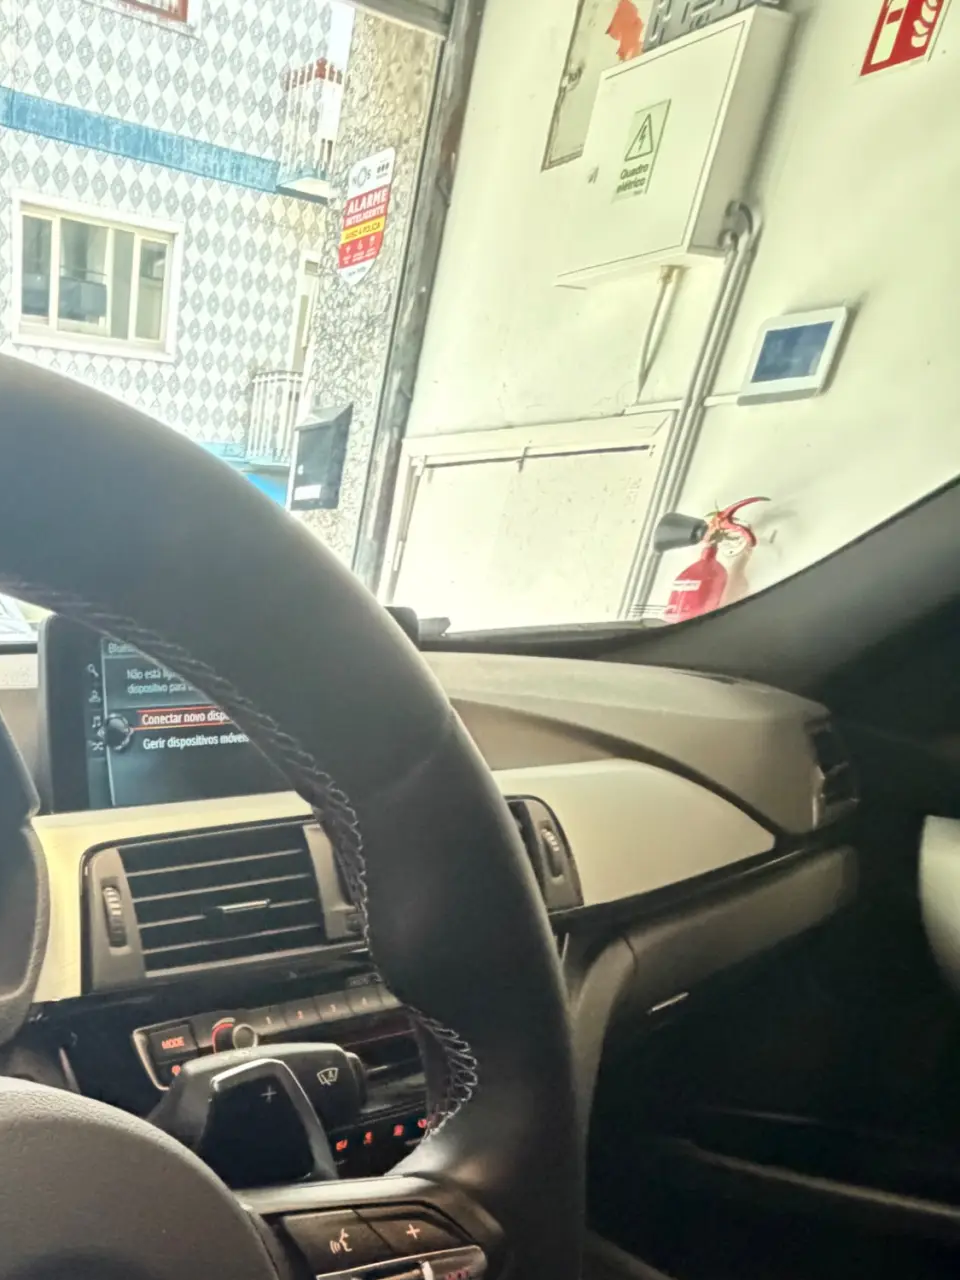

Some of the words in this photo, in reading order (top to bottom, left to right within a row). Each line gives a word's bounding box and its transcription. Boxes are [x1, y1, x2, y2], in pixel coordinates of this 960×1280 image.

[619, 163, 649, 180] Quadro
[347, 187, 388, 215] ALARME
[127, 669, 143, 681] Não
[144, 669, 161, 680] está
[127, 683, 168, 695] dispositivo
[169, 682, 187, 694] para
[141, 713, 182, 725] Conectar
[184, 712, 205, 723] novo
[143, 737, 166, 750] Gerir
[167, 734, 218, 750] dispositivos
[161, 1036, 185, 1049] MODE
